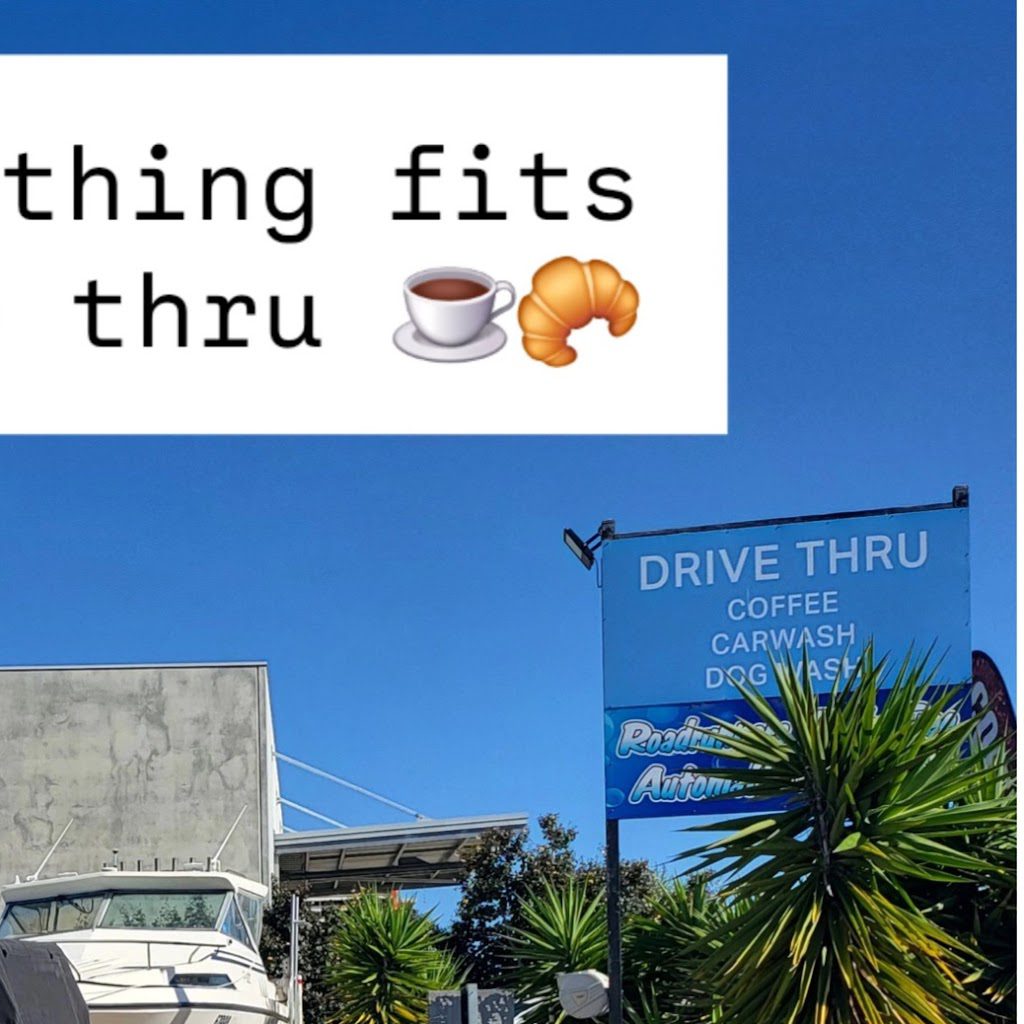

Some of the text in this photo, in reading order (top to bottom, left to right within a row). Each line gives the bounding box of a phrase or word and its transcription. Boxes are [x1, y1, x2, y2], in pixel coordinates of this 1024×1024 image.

[639, 531, 928, 591] DRIVE THRU
[727, 591, 839, 621] COFFEE
[711, 622, 856, 655] CARWASH
[705, 663, 768, 689] DOG
